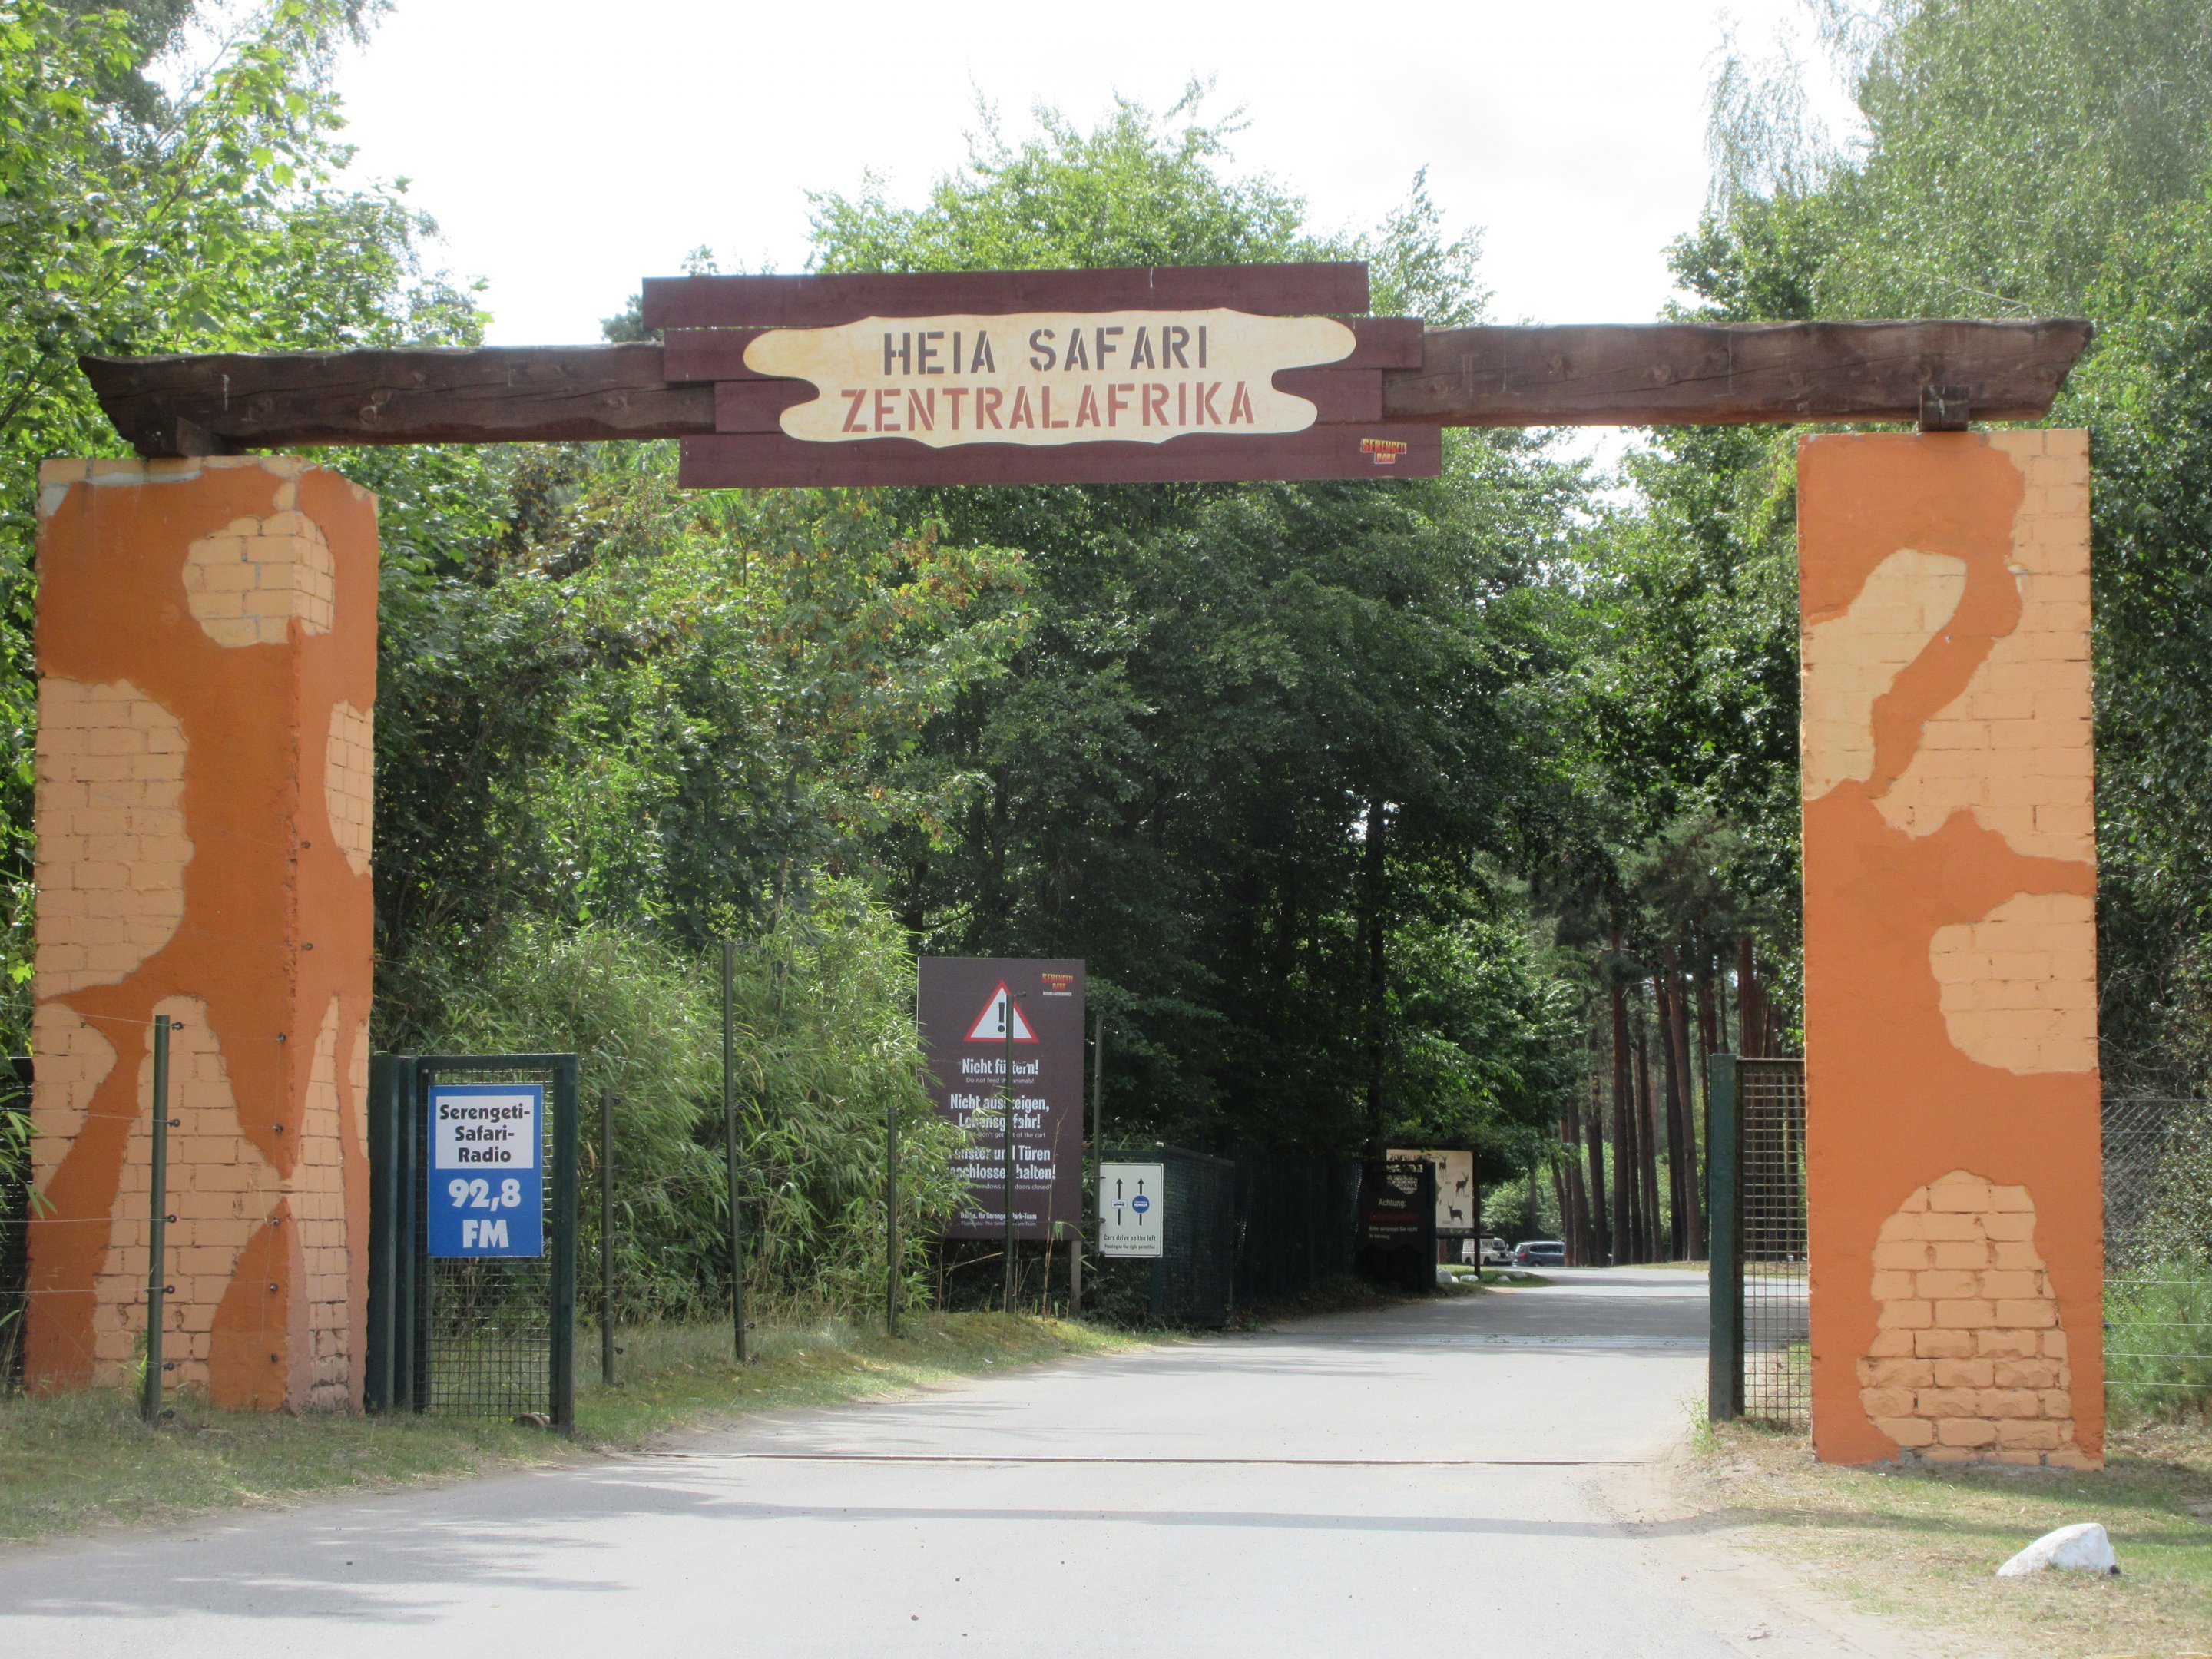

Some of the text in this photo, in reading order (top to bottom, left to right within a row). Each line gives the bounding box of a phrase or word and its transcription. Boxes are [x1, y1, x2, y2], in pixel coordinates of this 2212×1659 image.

[884, 325, 1207, 375] HEIA SAFARI
[840, 381, 1254, 432] ZENTRALAFRIKA
[962, 1058, 992, 1074] Nicht
[950, 1094, 981, 1109] Nicht
[439, 1103, 531, 1123] Serengeti-
[455, 1124, 515, 1141] Safari-
[458, 1147, 512, 1163] Radio
[1018, 1144, 1051, 1161] Türen
[1016, 1164, 1056, 1180] halten!
[449, 1178, 522, 1212] 92,8
[1378, 1198, 1406, 1209] Achtung:
[462, 1219, 509, 1248] FM
